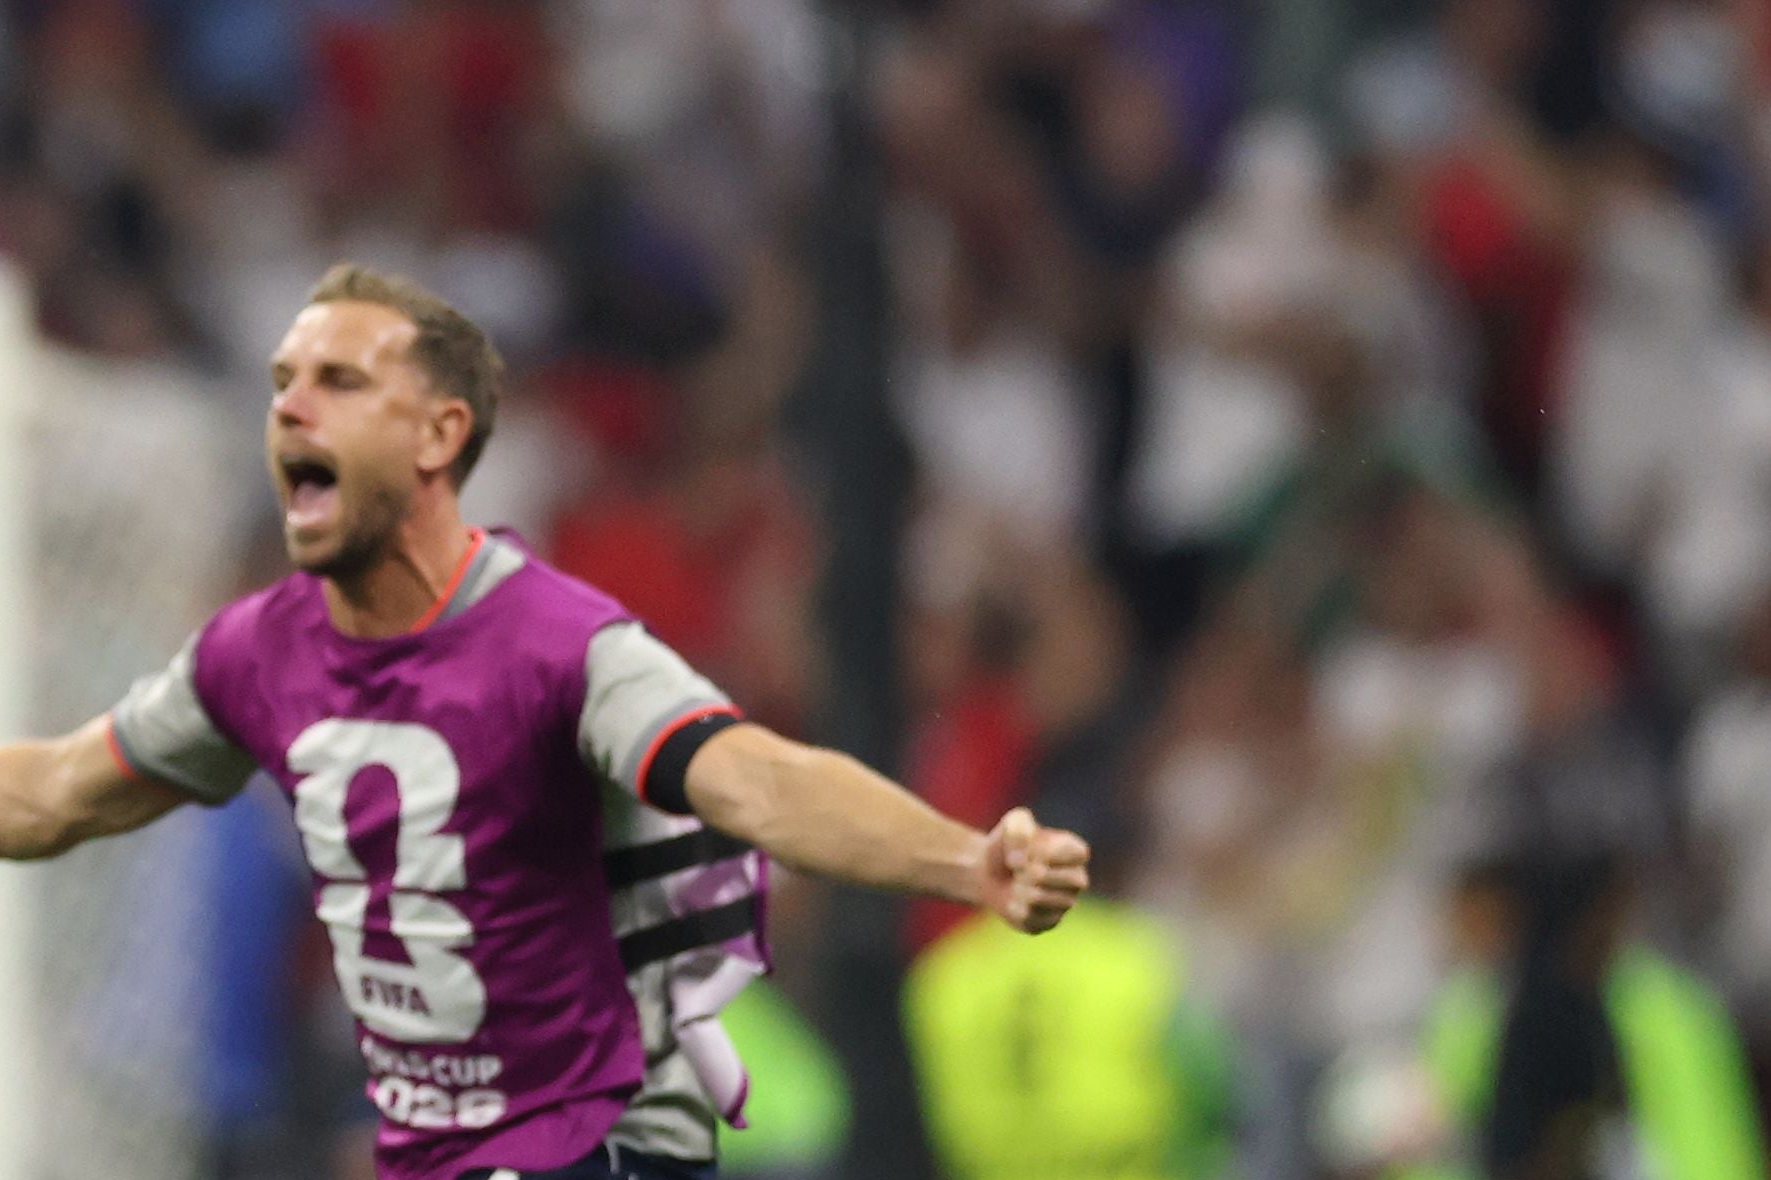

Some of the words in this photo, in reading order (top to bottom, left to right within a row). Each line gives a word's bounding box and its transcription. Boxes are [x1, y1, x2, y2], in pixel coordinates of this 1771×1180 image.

[361, 974, 432, 1018] FIFA
[430, 1053, 504, 1087] CUP
[369, 1074, 508, 1130] 026
